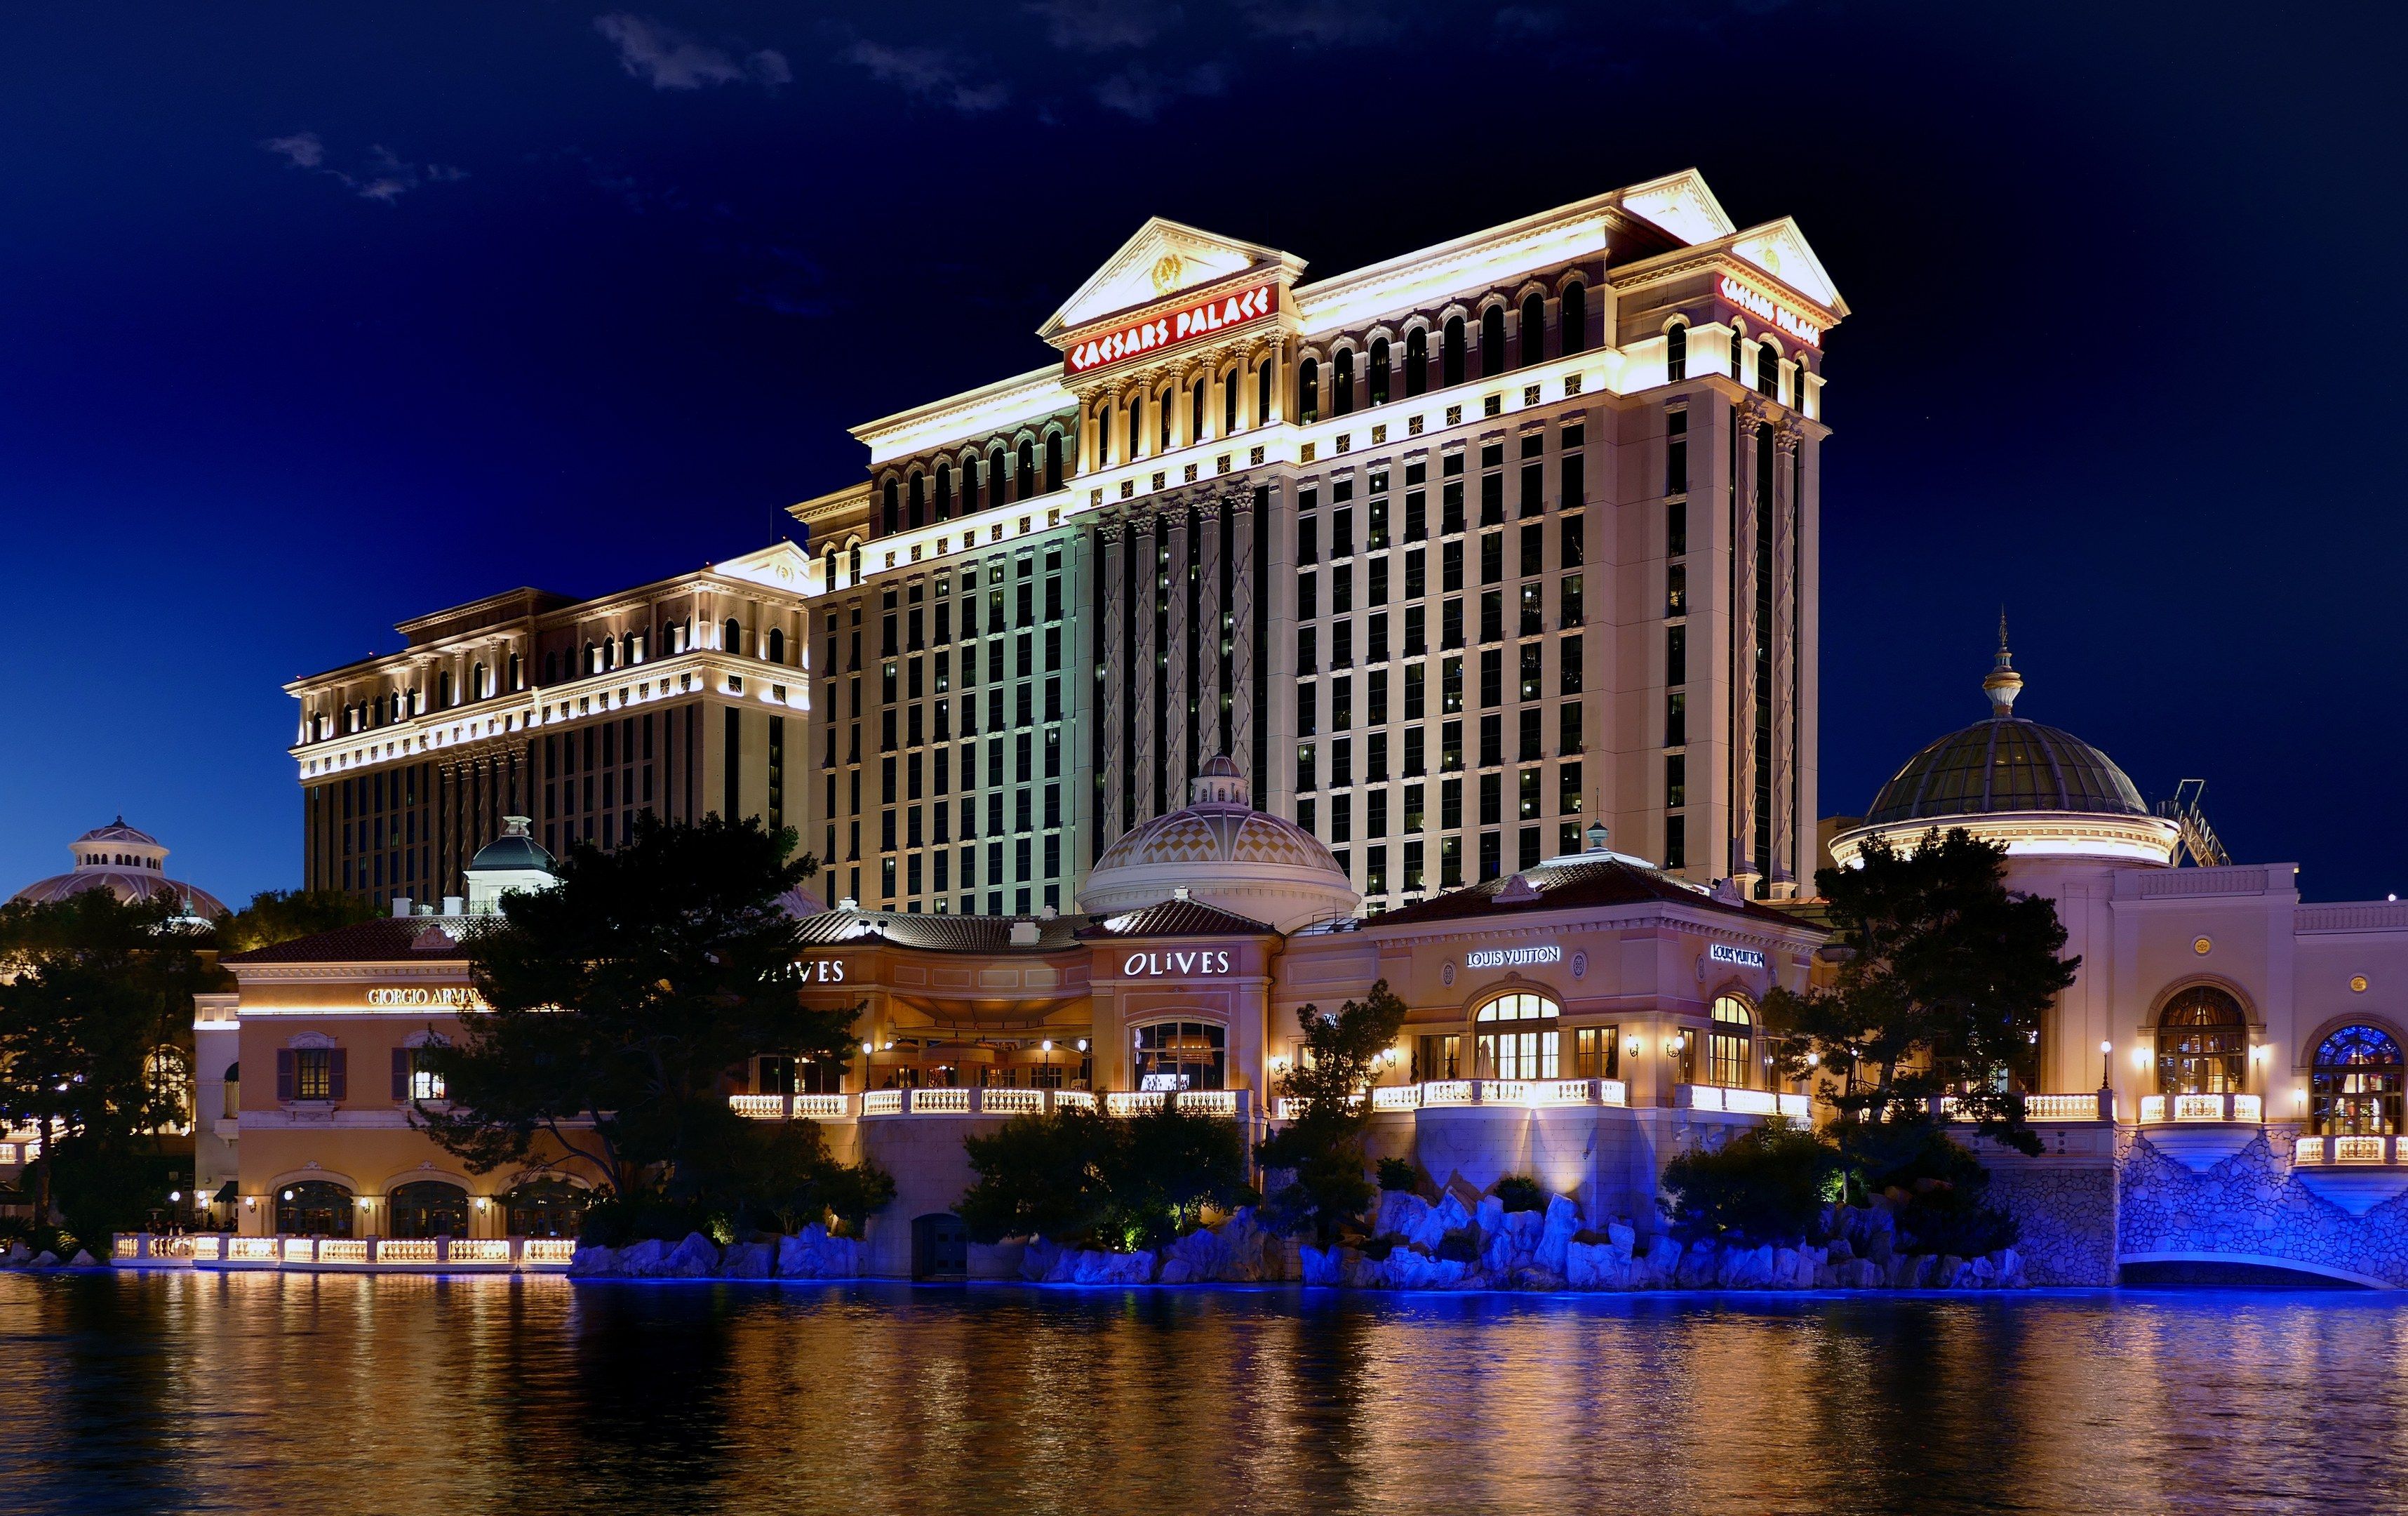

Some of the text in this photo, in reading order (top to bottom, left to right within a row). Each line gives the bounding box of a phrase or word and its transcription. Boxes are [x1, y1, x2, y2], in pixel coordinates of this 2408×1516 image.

[1720, 277, 1774, 322] CAESARS
[1071, 286, 1269, 370] CAESARS PALACE
[1466, 946, 1559, 967] LOUIS VUITTON
[1711, 945, 1765, 967] LOUIS VUITTON
[367, 988, 488, 1005] GIORGIO ARMAN
